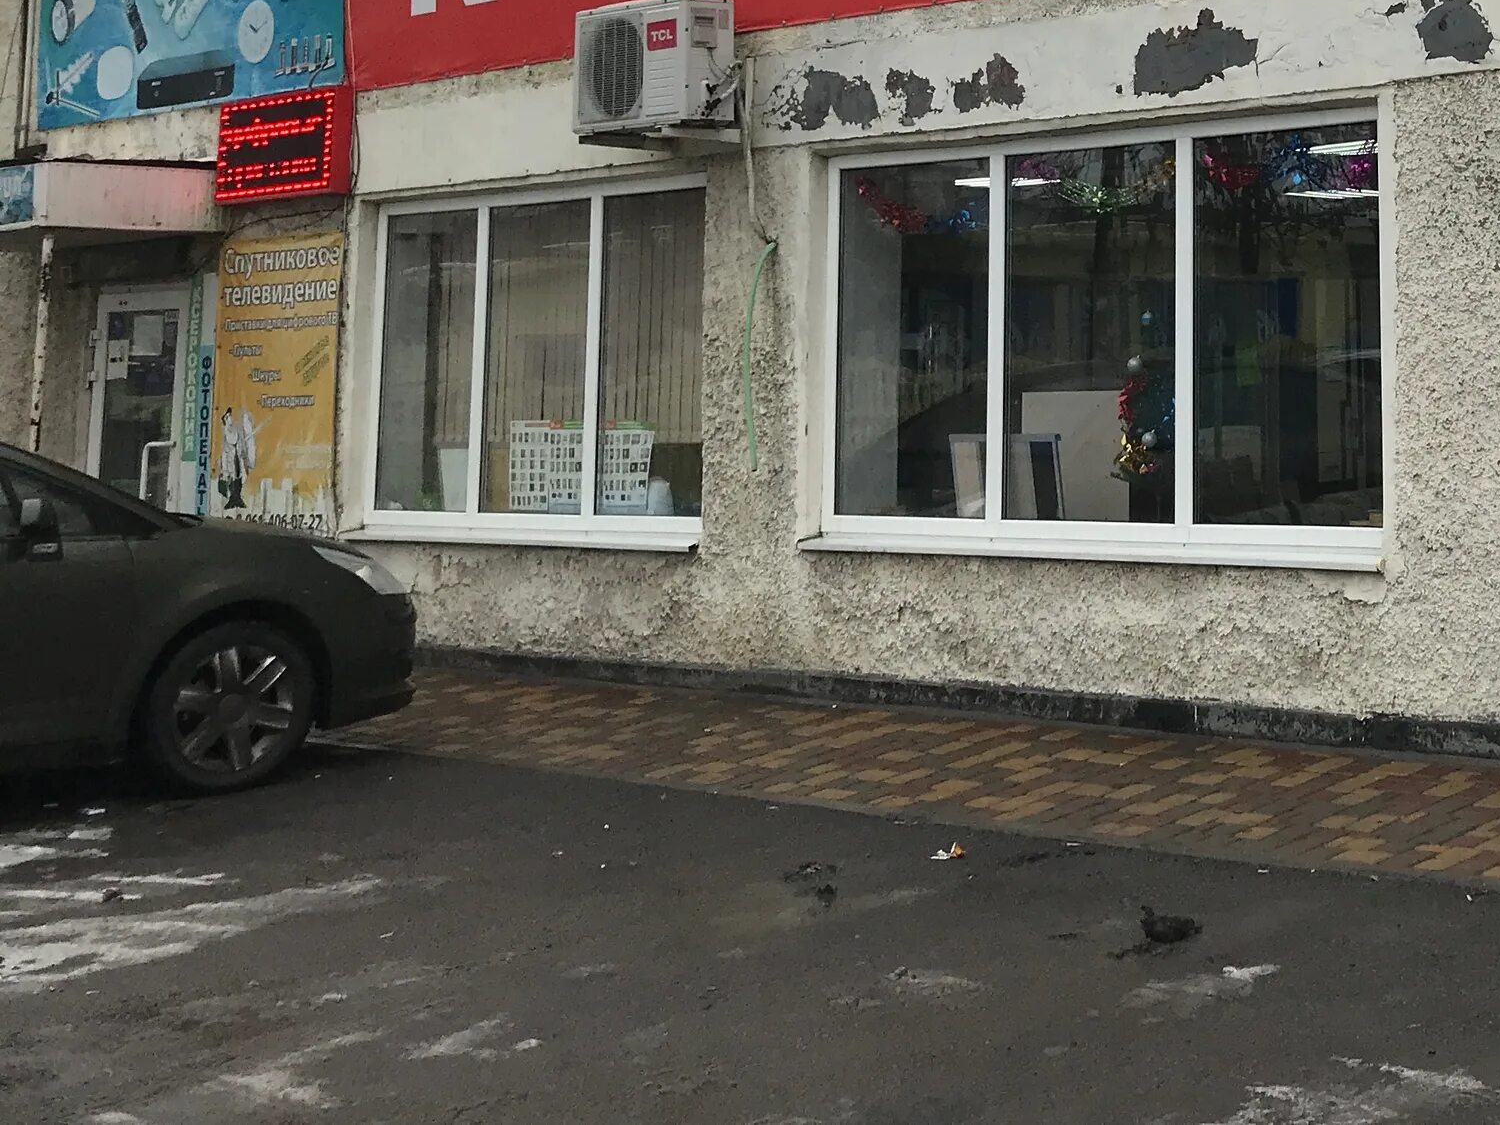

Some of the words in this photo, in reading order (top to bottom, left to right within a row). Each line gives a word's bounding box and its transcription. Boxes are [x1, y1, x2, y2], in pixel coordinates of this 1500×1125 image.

[650, 28, 674, 43] TCL
[224, 246, 341, 280] Спутниковое
[223, 278, 338, 310] телевидение
[184, 285, 202, 452] КСЕРОКОПИЯ
